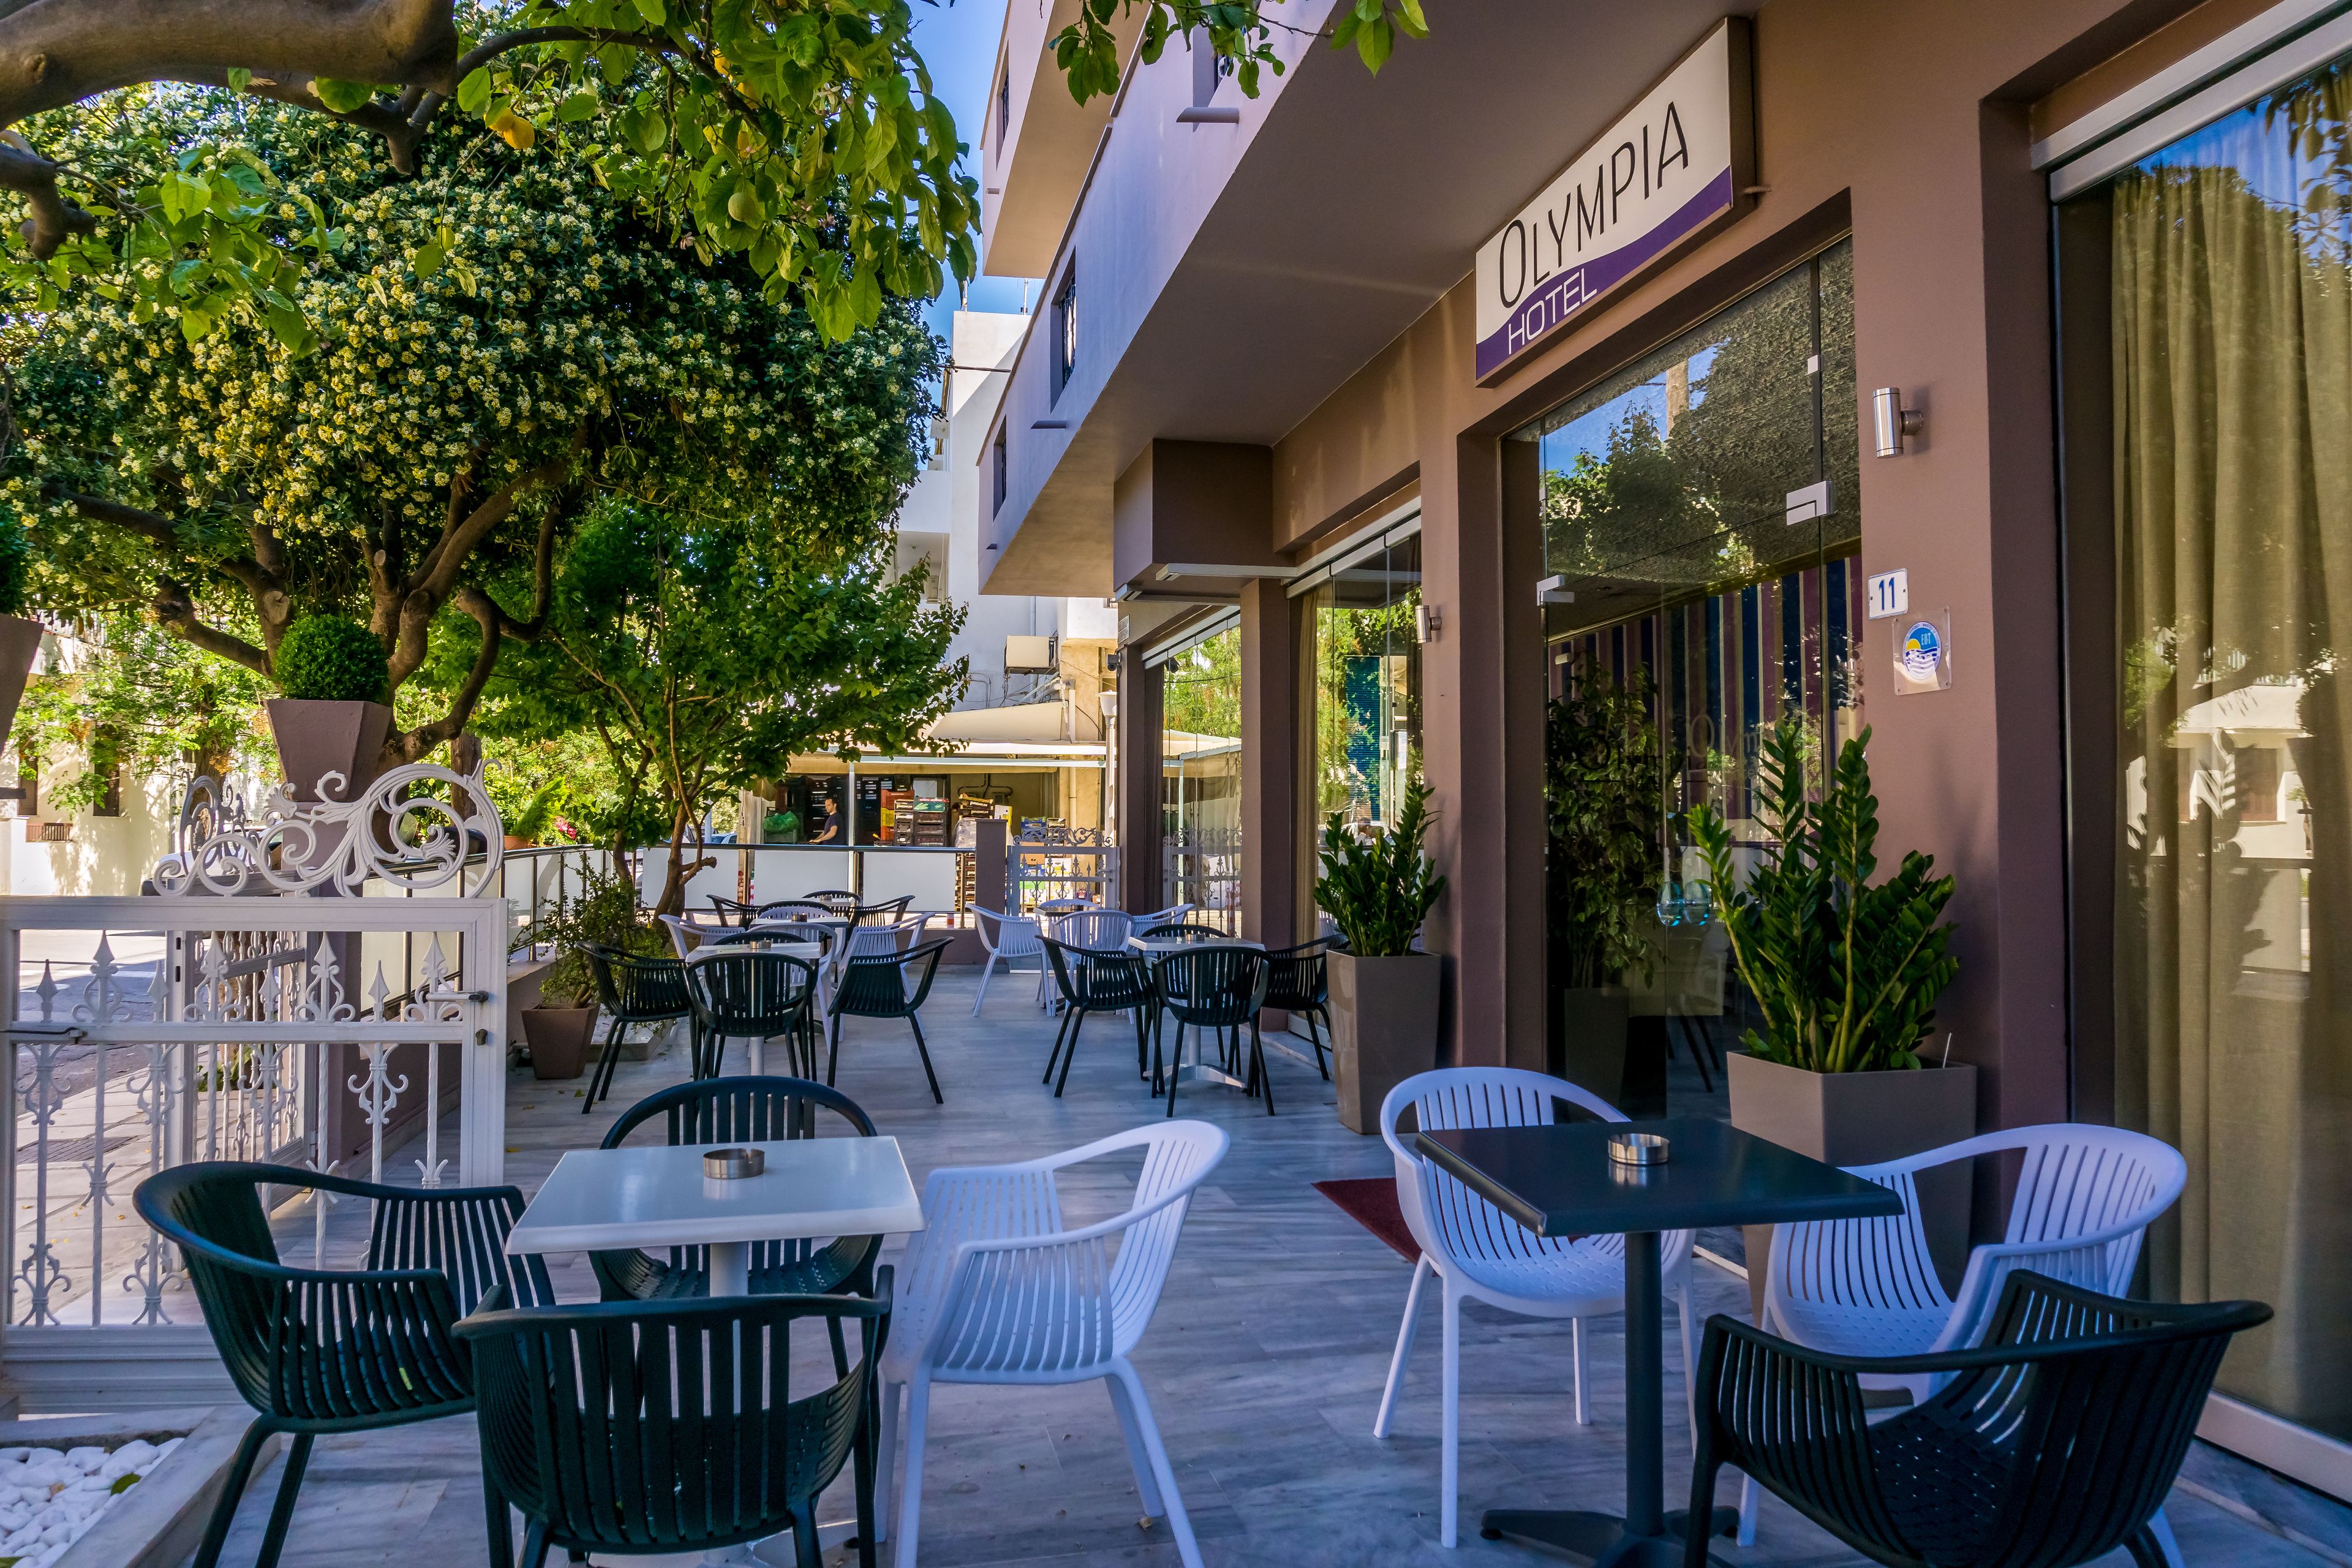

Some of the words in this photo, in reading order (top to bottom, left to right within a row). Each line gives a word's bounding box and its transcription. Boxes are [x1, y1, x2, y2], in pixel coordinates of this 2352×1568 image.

[1499, 101, 1689, 309] OLYMPIA
[1508, 268, 1597, 355] HOTEL
[1878, 577, 1896, 611] 11
